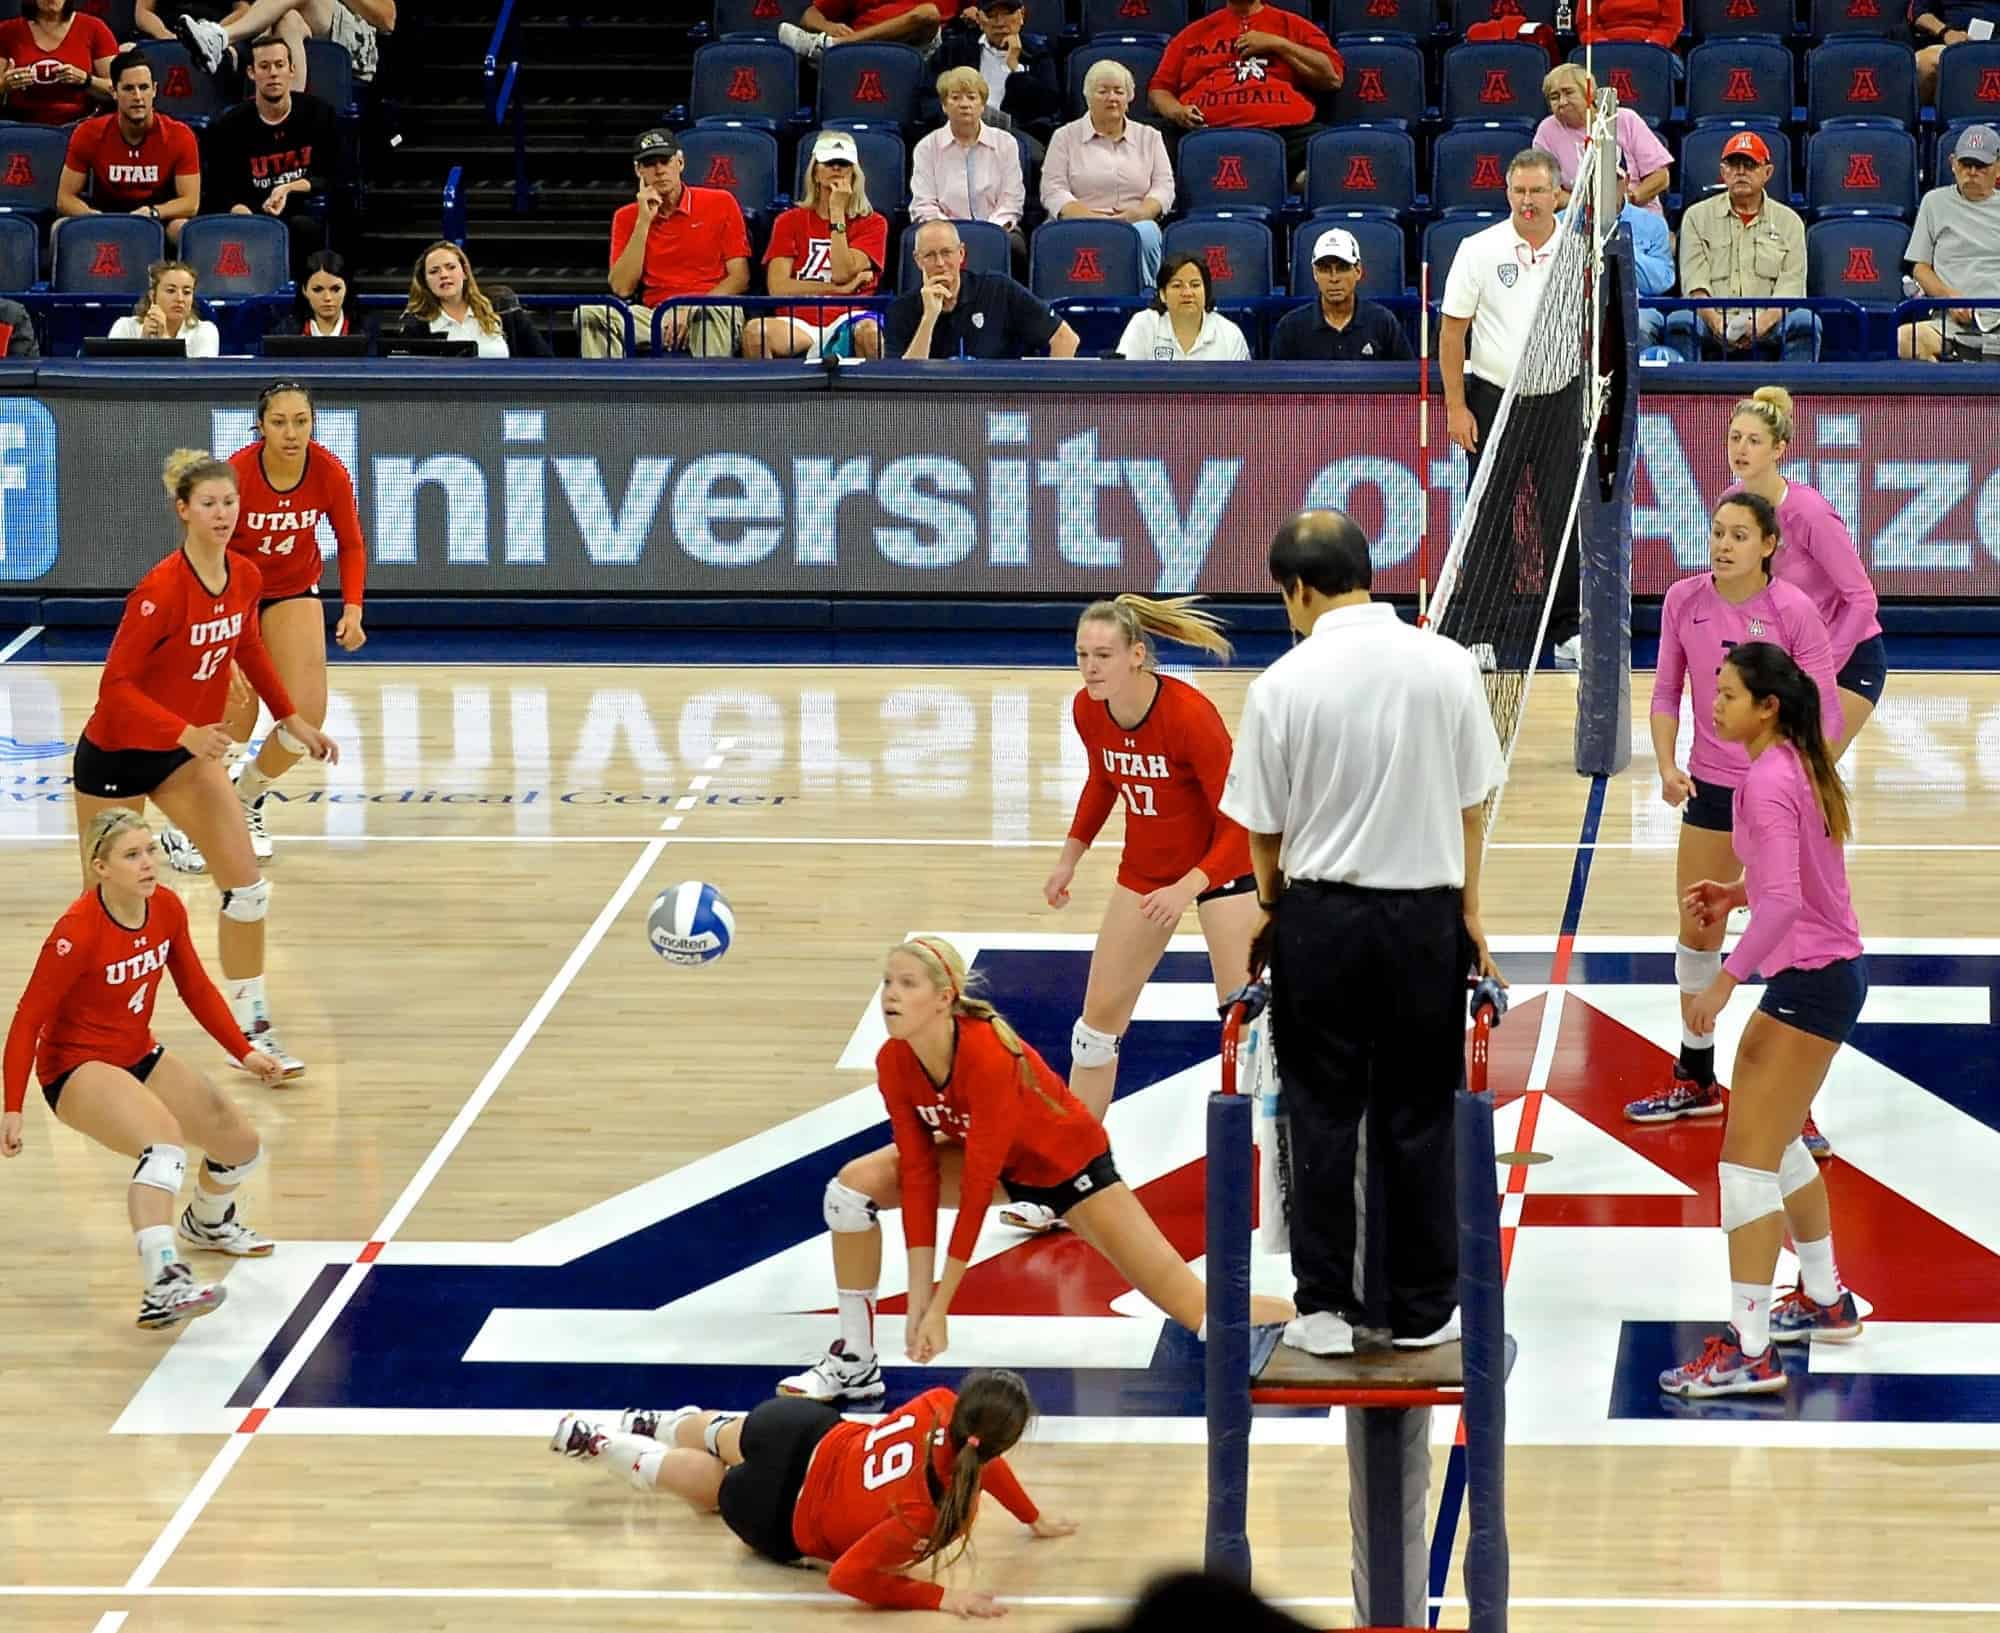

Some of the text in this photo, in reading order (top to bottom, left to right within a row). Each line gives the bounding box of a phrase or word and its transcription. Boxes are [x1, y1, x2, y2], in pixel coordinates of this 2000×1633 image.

[1186, 87, 1291, 107] OOTBALL
[108, 164, 159, 183] UTAH
[1631, 413, 2000, 571] Aiz
[247, 509, 318, 531] UTAH
[257, 534, 297, 556] 14
[190, 613, 243, 646] UTAH
[1102, 746, 1170, 779] UTAH
[260, 789, 801, 805] Medical Center
[1121, 783, 1159, 817] 17
[659, 934, 707, 950] molten
[105, 938, 171, 985] UTAH
[127, 982, 149, 1015] 4
[863, 1414, 917, 1490] 19
